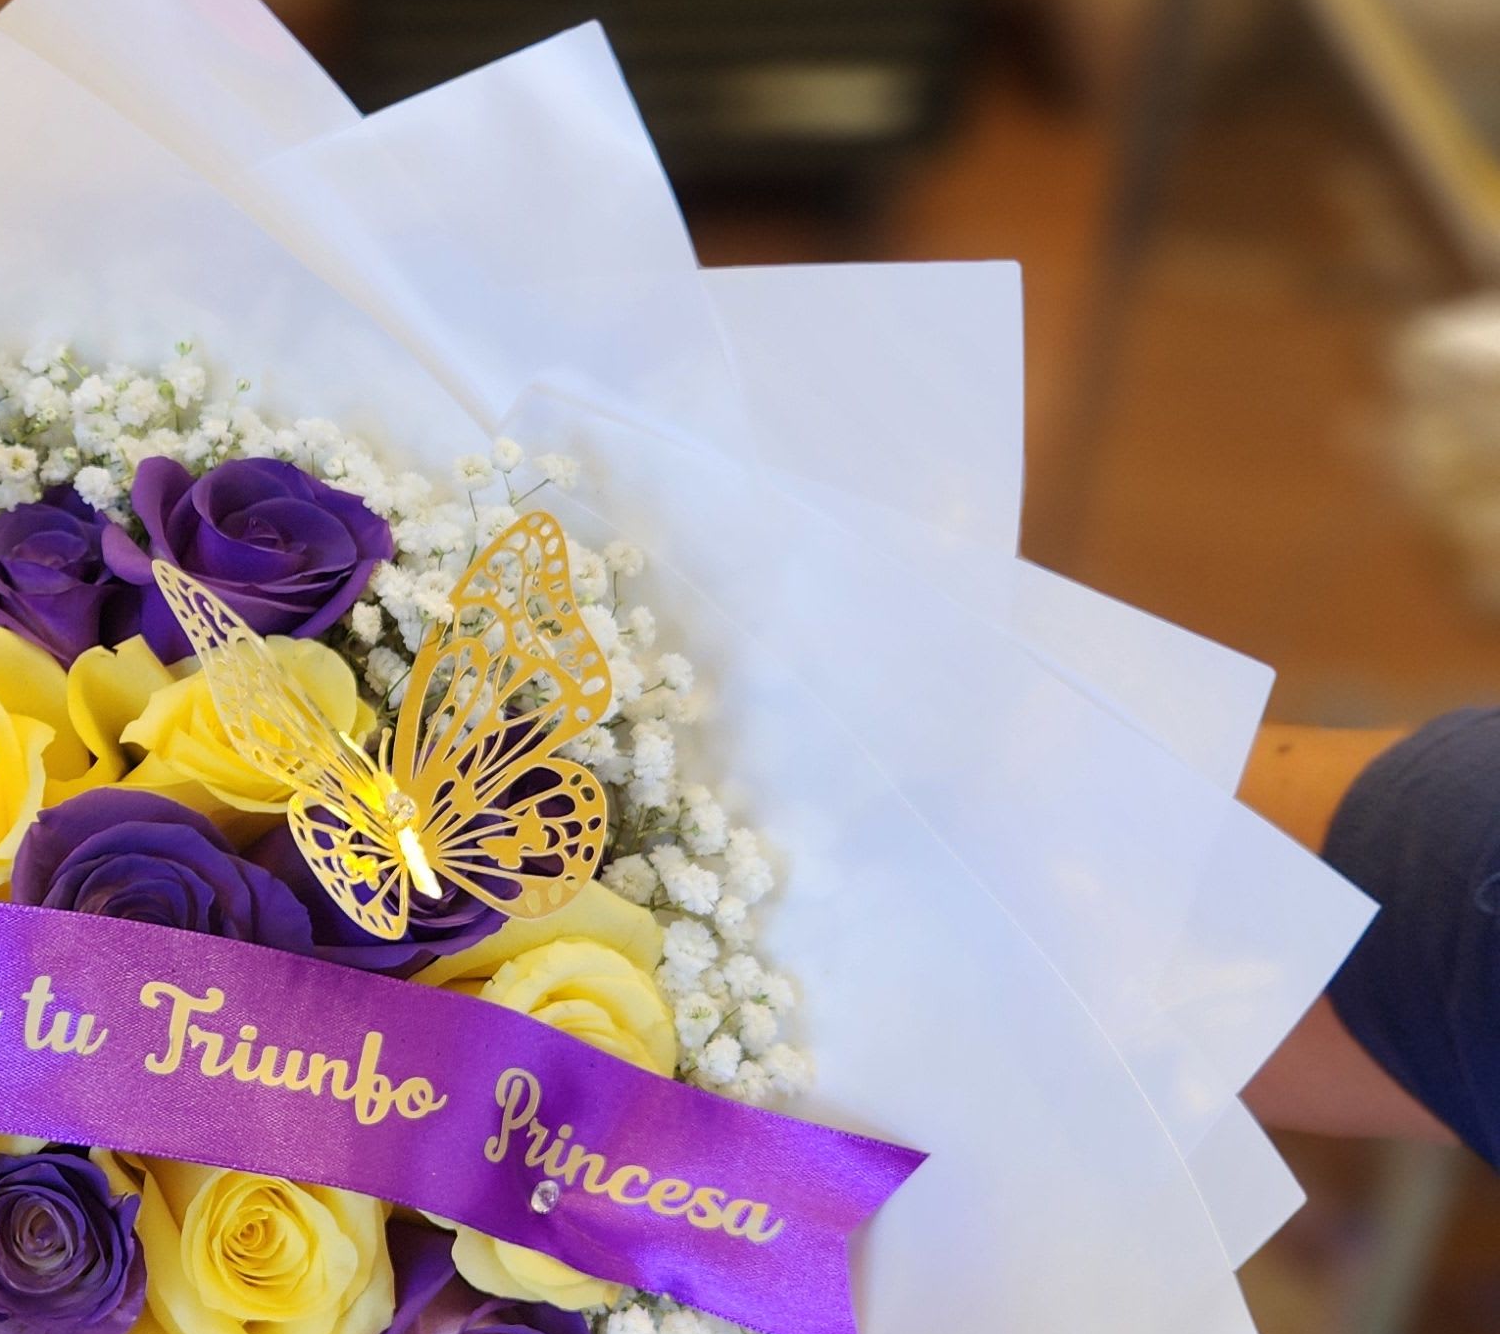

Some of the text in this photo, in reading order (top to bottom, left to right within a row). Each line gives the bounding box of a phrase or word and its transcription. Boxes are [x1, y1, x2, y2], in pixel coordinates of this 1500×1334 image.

[23, 975, 108, 1056] tu
[139, 980, 447, 1126] Triunfo
[484, 1067, 784, 1244] Princesa
